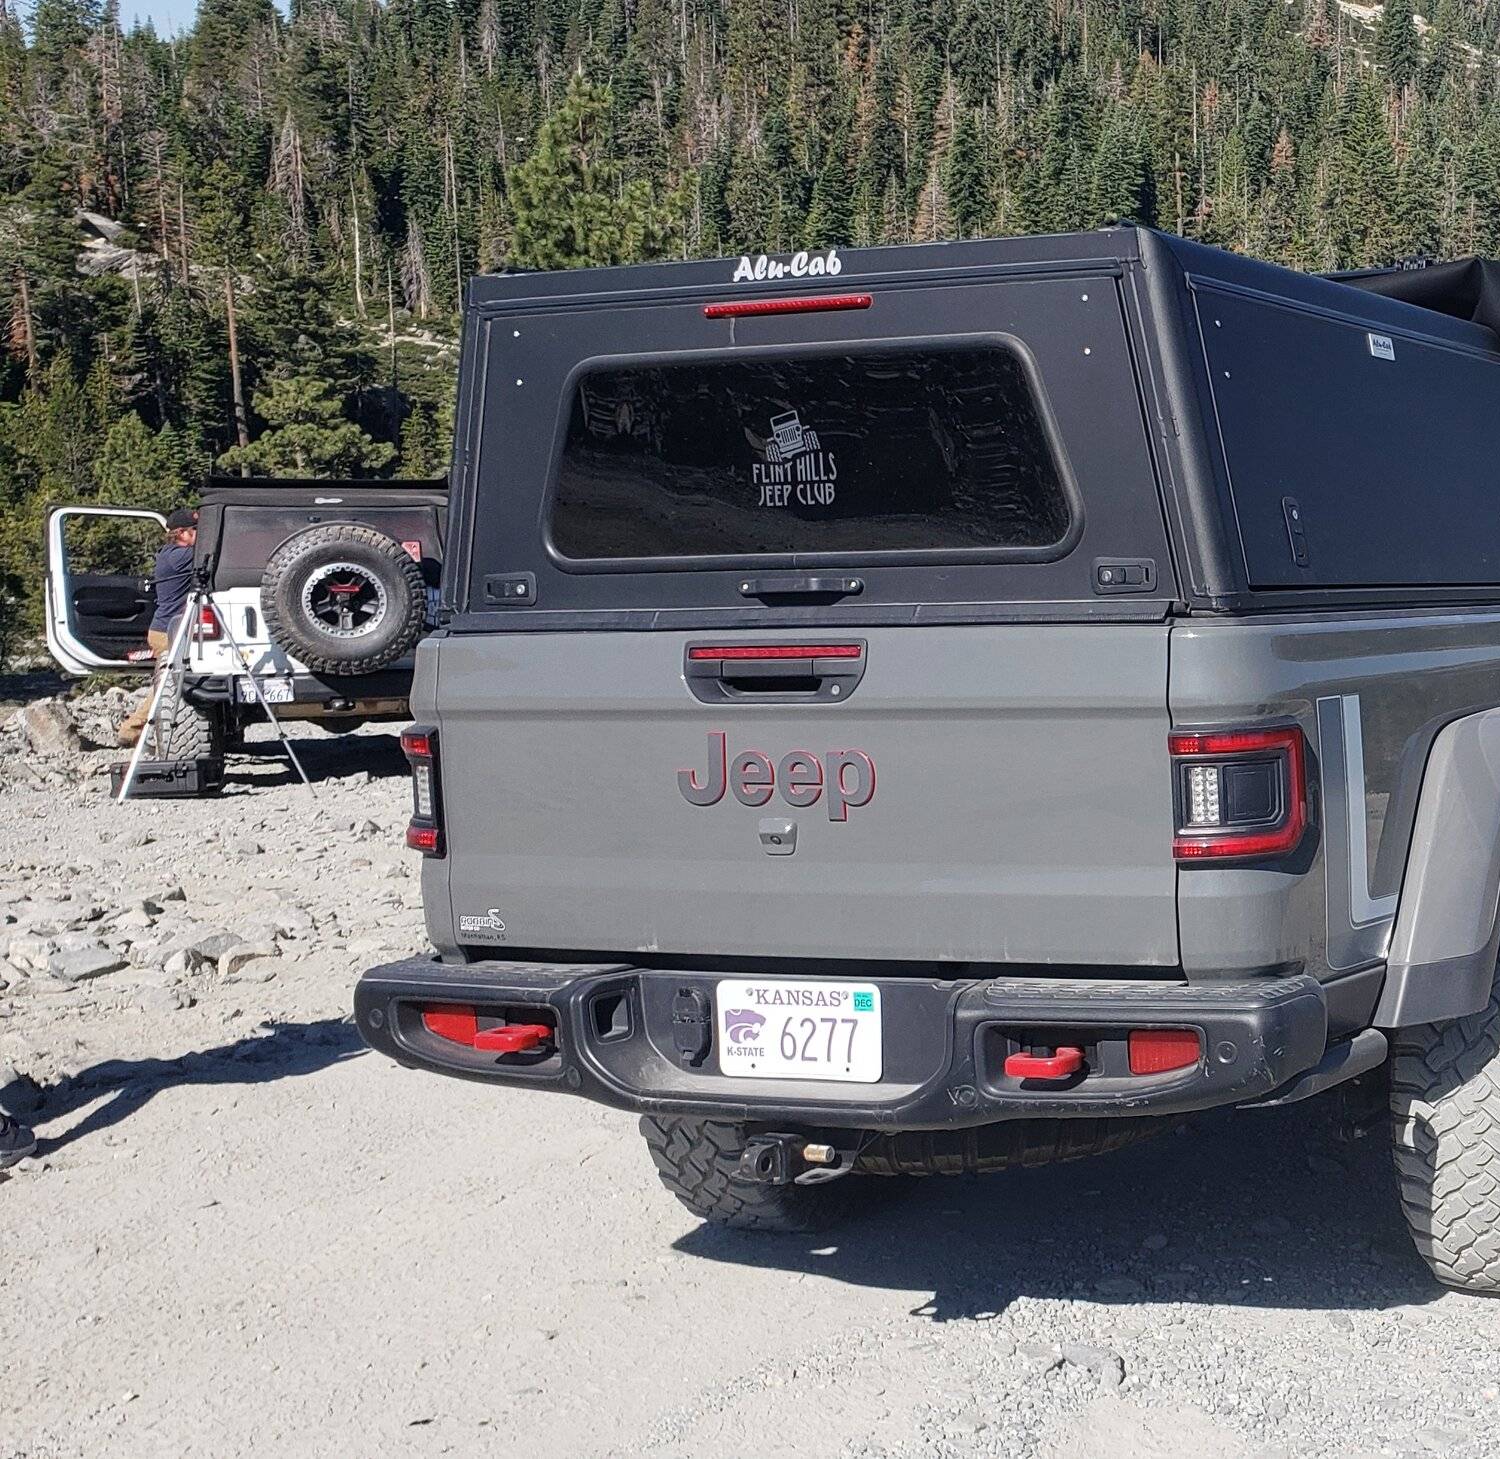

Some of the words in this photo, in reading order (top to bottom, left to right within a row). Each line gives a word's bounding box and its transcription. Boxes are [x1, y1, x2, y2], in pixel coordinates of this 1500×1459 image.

[733, 250, 842, 282] Alu-Cab
[752, 461, 793, 483] FLINT
[796, 452, 837, 481] HILLS
[758, 485, 792, 506] JEEP
[796, 483, 836, 505] CLUB
[677, 731, 878, 822] Jeep
[754, 988, 842, 1007] KANSAS
[855, 998, 872, 1008] DEC
[726, 1046, 765, 1057] K-STATE
[780, 1016, 859, 1063] 6277
